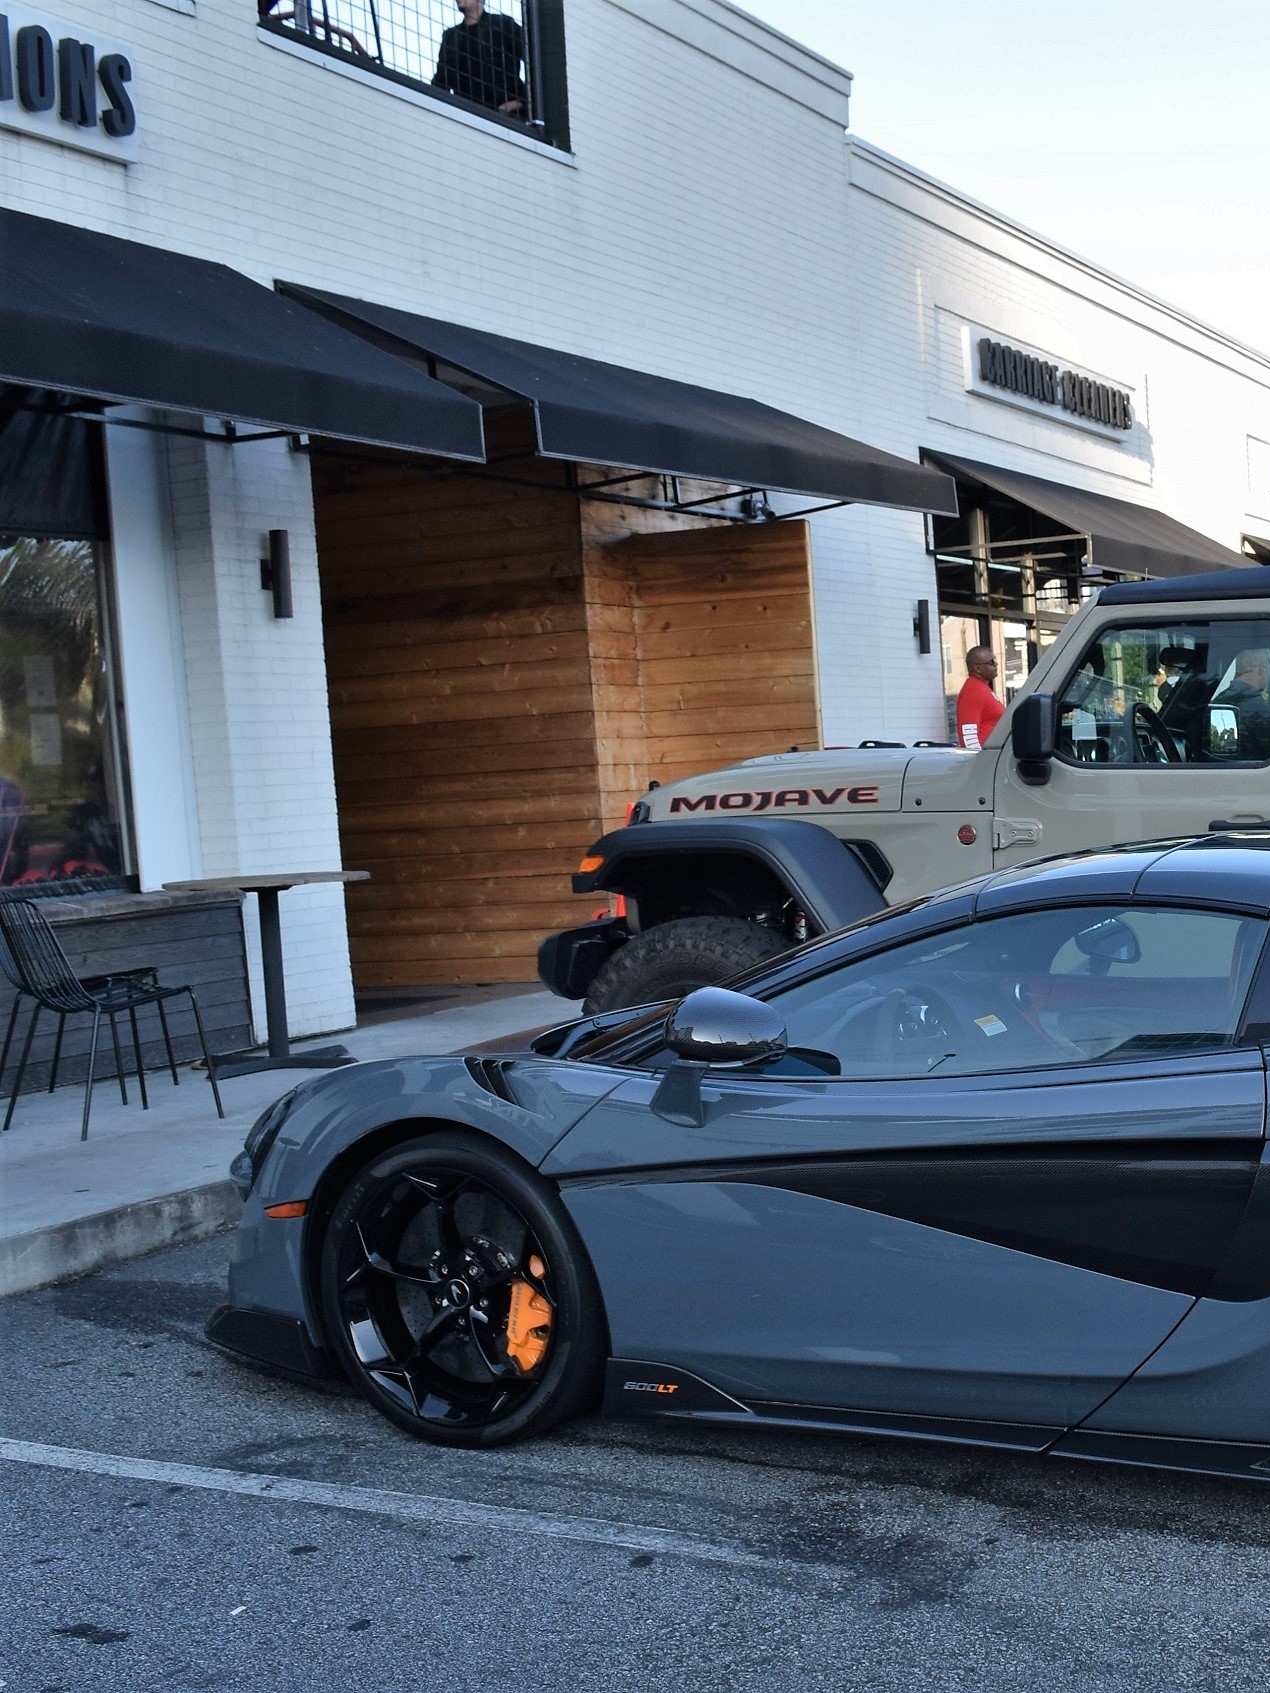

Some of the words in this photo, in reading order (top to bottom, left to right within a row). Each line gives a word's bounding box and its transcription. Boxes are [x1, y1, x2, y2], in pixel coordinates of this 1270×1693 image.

[979, 338, 1059, 405] CARRIAGE
[1062, 371, 1132, 430] CLEANERS
[669, 786, 879, 813] MOJAVE
[623, 1381, 678, 1394] 600LT
